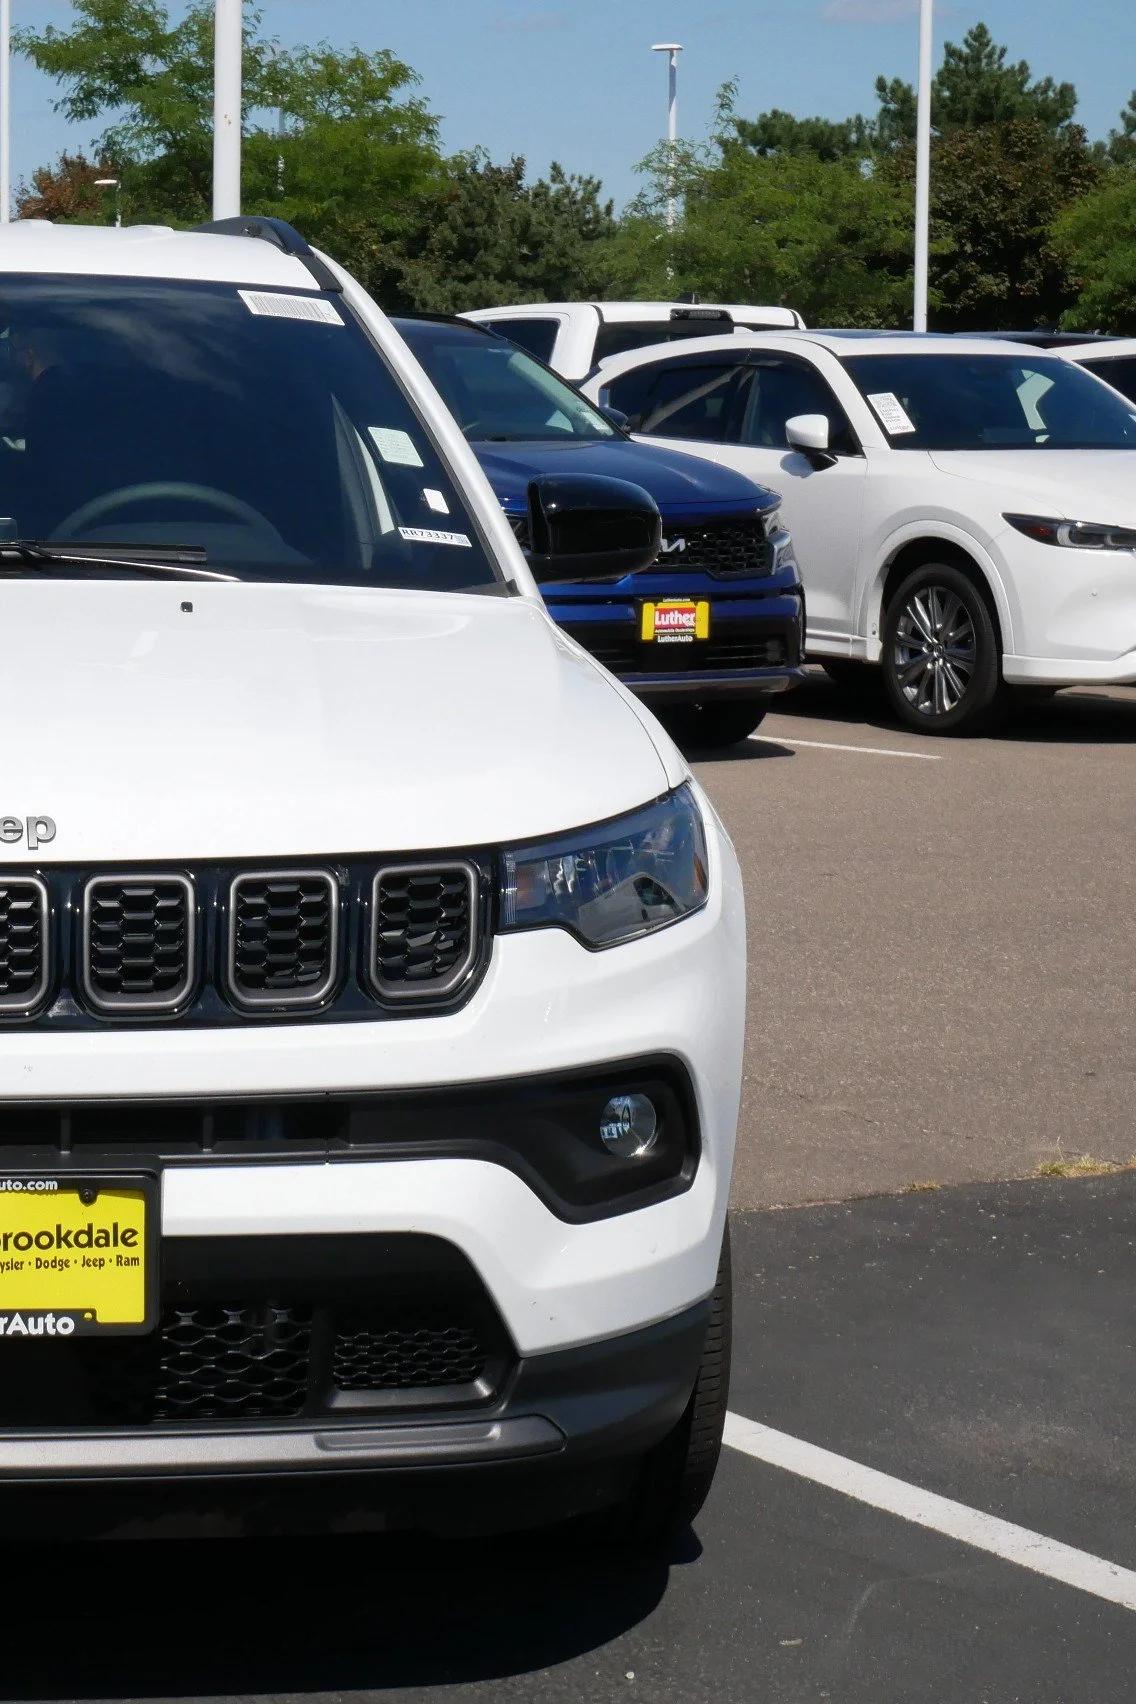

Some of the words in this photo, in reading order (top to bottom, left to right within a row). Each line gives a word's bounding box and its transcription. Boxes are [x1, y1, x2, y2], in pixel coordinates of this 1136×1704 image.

[655, 610, 695, 626] Luther
[657, 634, 693, 643] LutherAuto
[35, 1256, 71, 1272] Dodge
[81, 1255, 106, 1270] Jeep
[116, 1254, 140, 1268] Ram
